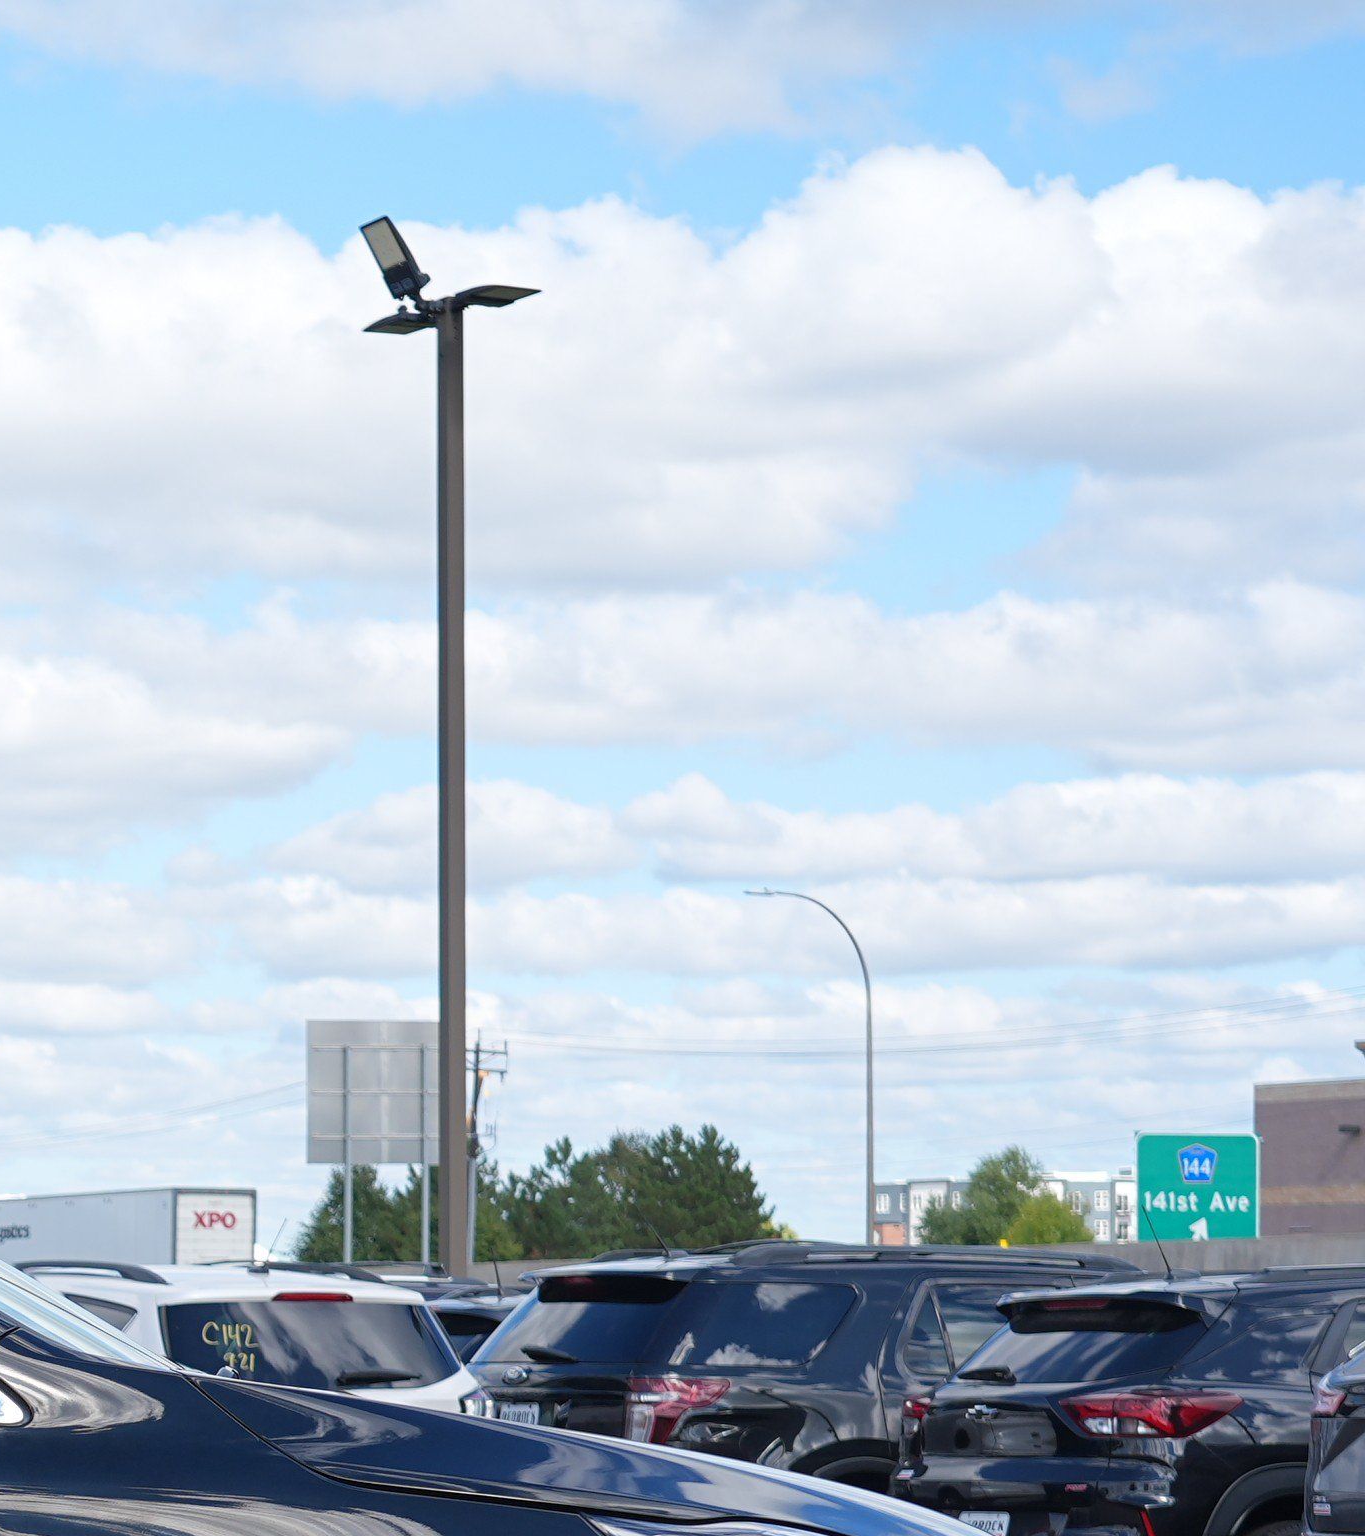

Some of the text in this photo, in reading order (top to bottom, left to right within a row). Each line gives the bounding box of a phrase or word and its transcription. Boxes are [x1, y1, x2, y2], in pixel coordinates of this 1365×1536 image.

[1182, 1157, 1211, 1177] 144
[1143, 1190, 1251, 1212] 141st Ave
[194, 1210, 236, 1230] XPO
[201, 1321, 260, 1349] C142
